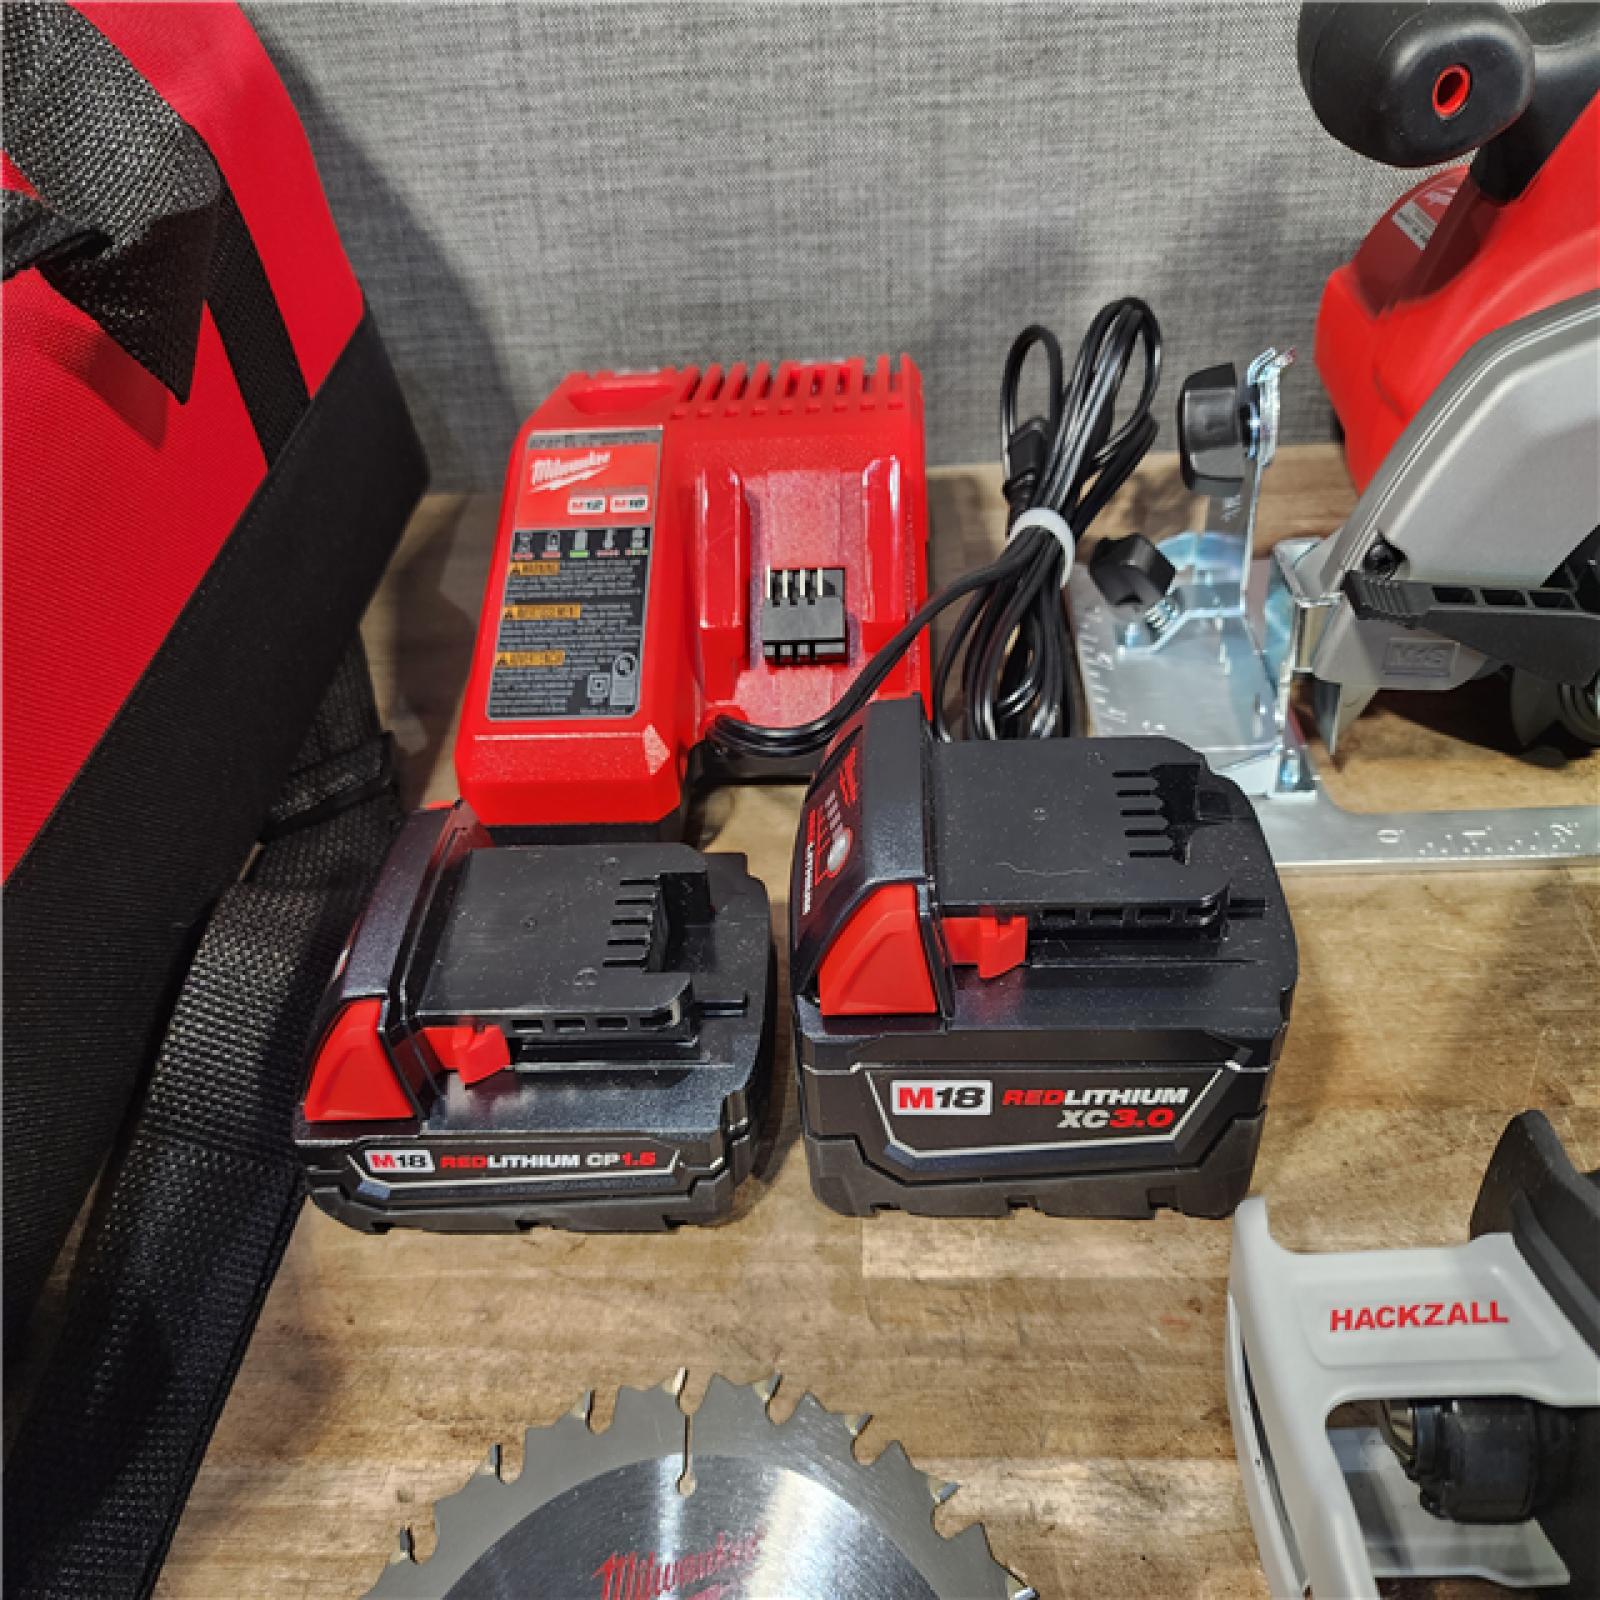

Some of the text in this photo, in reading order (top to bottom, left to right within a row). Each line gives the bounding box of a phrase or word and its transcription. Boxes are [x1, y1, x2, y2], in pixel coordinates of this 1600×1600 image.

[899, 1086, 1190, 1110] M18 REDLITHIUM
[1056, 1109, 1175, 1130] XC3.0
[370, 1154, 428, 1170] M18
[439, 1153, 581, 1170] REDLITHIUM
[1329, 1300, 1510, 1333] HACKZALL
